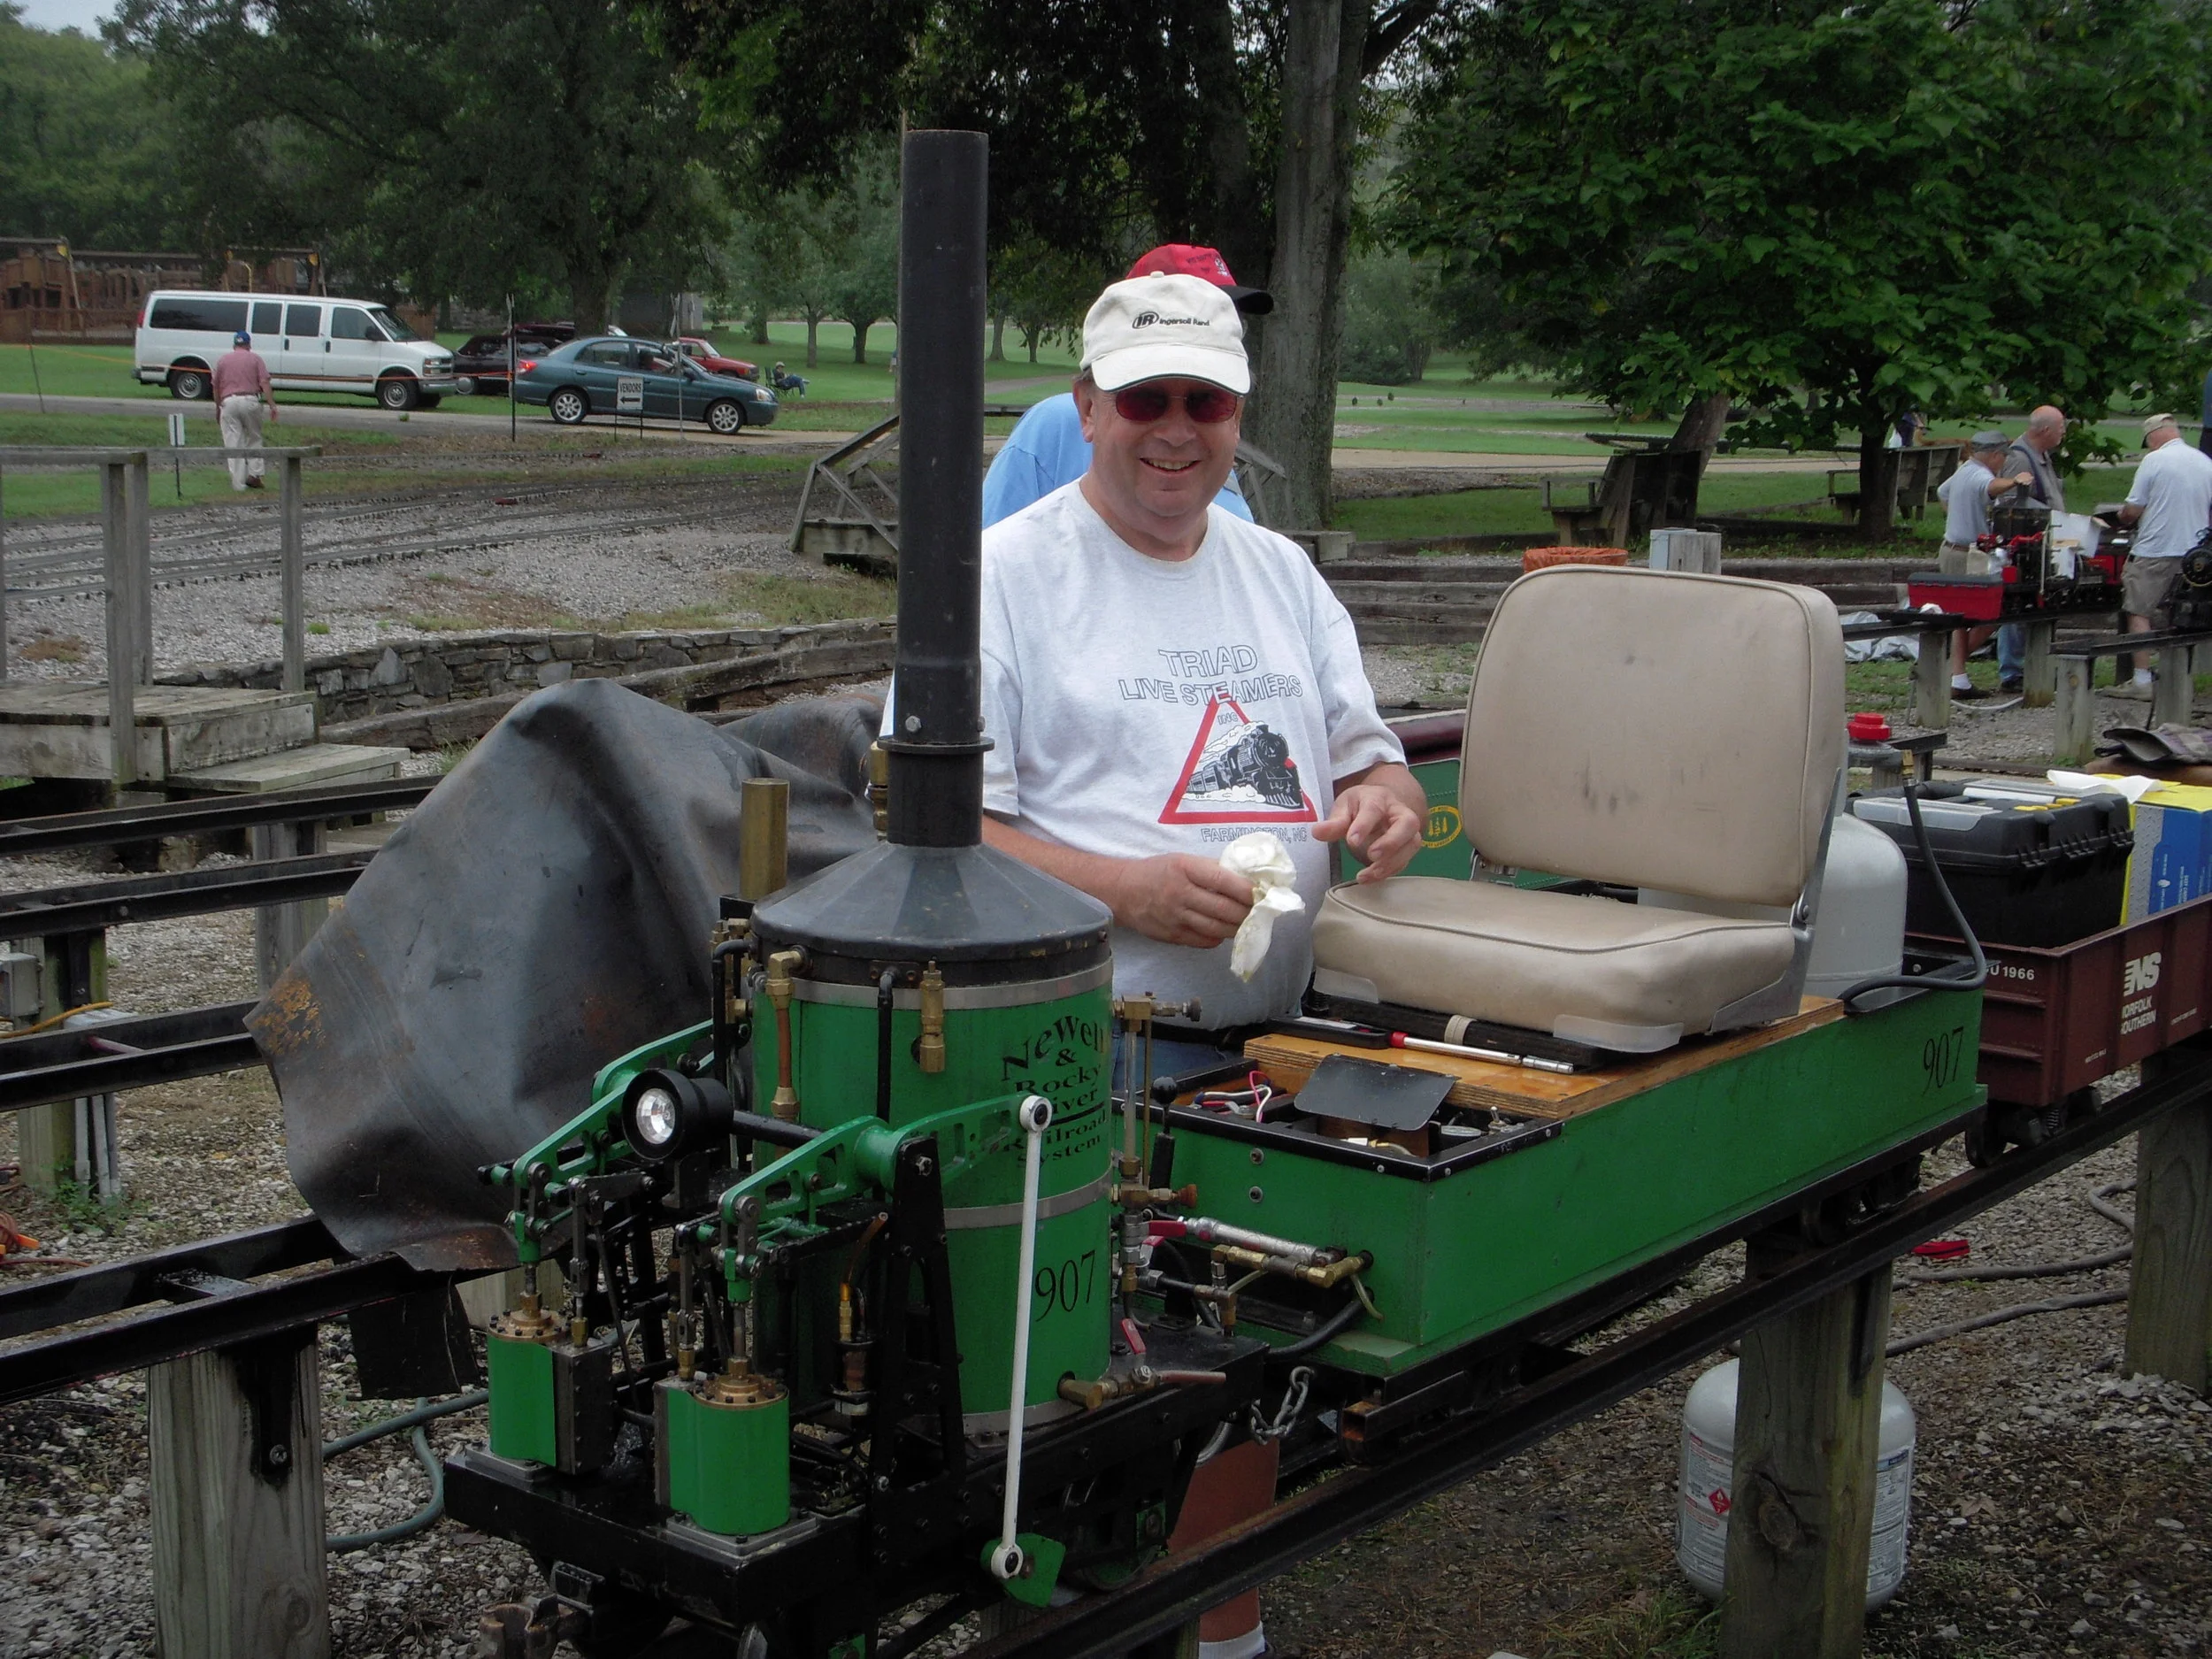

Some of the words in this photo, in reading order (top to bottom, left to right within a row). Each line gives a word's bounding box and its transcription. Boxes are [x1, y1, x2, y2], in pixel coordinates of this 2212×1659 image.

[1135, 313, 1156, 327] IR
[620, 381, 642, 393] VENDORS
[1158, 644, 1257, 678] TRIAD
[1118, 678, 1179, 703] LIVE
[1179, 672, 1303, 706] STEAMERS
[1217, 711, 1239, 725] INC
[1294, 827, 1307, 841] NC
[2002, 965, 2035, 980] 1966
[2124, 951, 2162, 997] NS
[1055, 1048, 1078, 1067] &
[1922, 1026, 1964, 1097] 907
[1052, 1088, 1098, 1115] iver
[1034, 1249, 1096, 1322] 907
